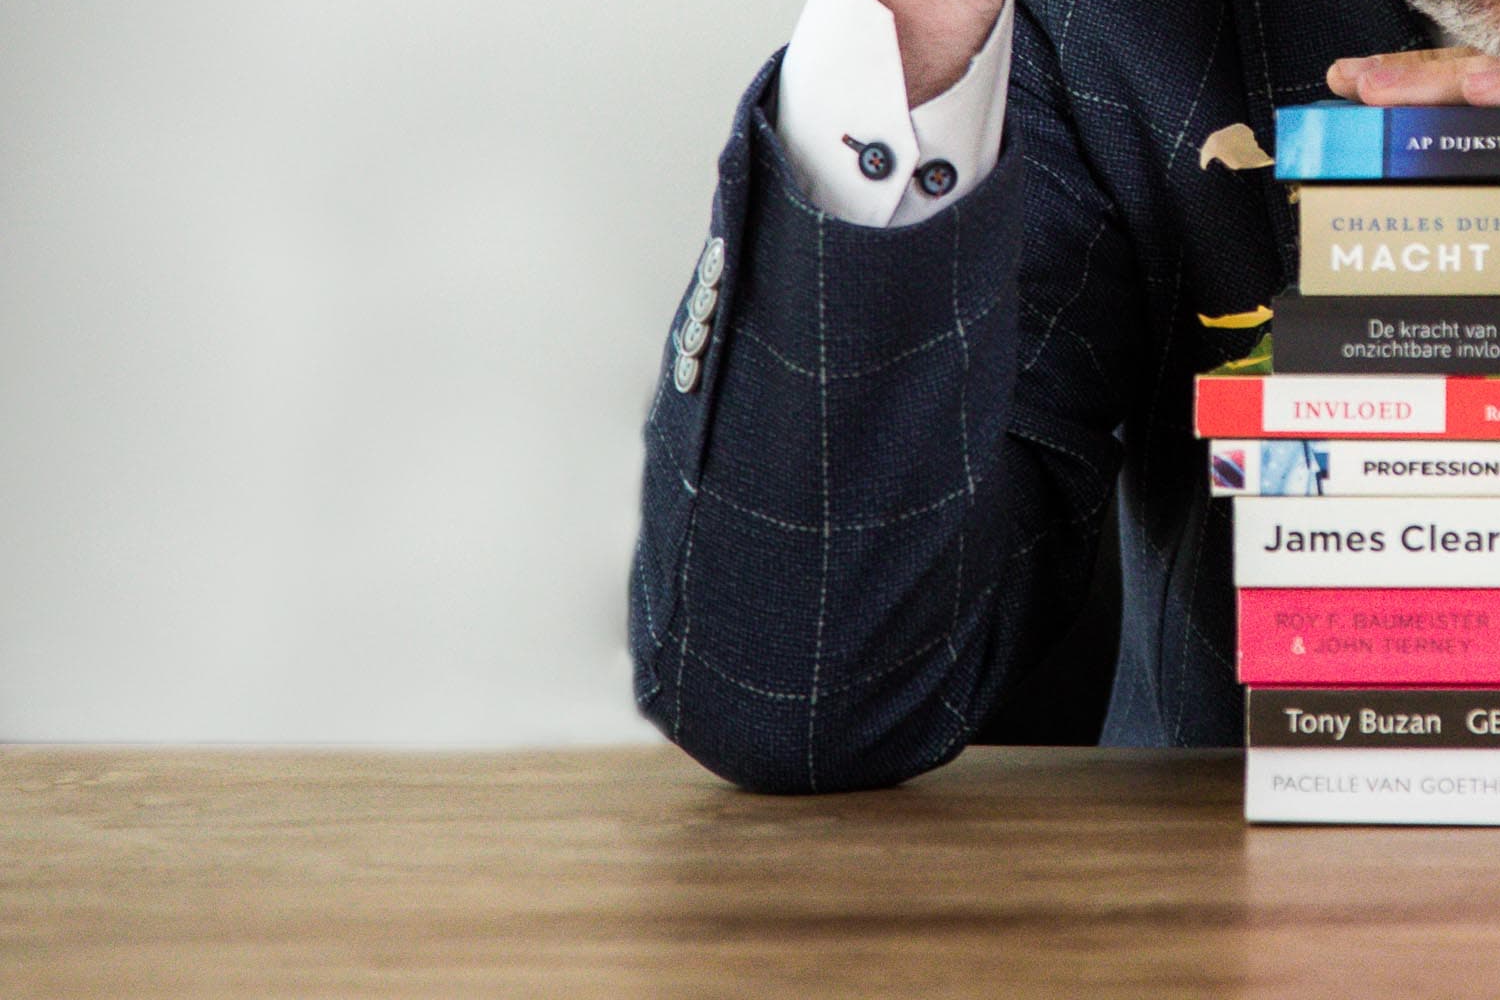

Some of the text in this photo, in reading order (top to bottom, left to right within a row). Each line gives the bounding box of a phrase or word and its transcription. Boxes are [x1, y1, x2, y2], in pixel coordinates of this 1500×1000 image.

[1407, 136, 1433, 151] AP
[1331, 217, 1445, 232] CHARLES
[1330, 243, 1491, 272] MACHT
[1368, 318, 1497, 338] De kracht van
[1342, 340, 1452, 358] onzichtbare
[1292, 401, 1413, 420] INVLOED
[1263, 523, 1500, 553] James Clear
[1276, 612, 1318, 630] ROY
[1353, 612, 1491, 630] BAUMEISTER
[1290, 636, 1473, 655] & JOHN TIERNEY
[1283, 708, 1442, 740] Tony Buzan
[1272, 775, 1359, 794] PACELLE
[1365, 776, 1412, 794] VAN
